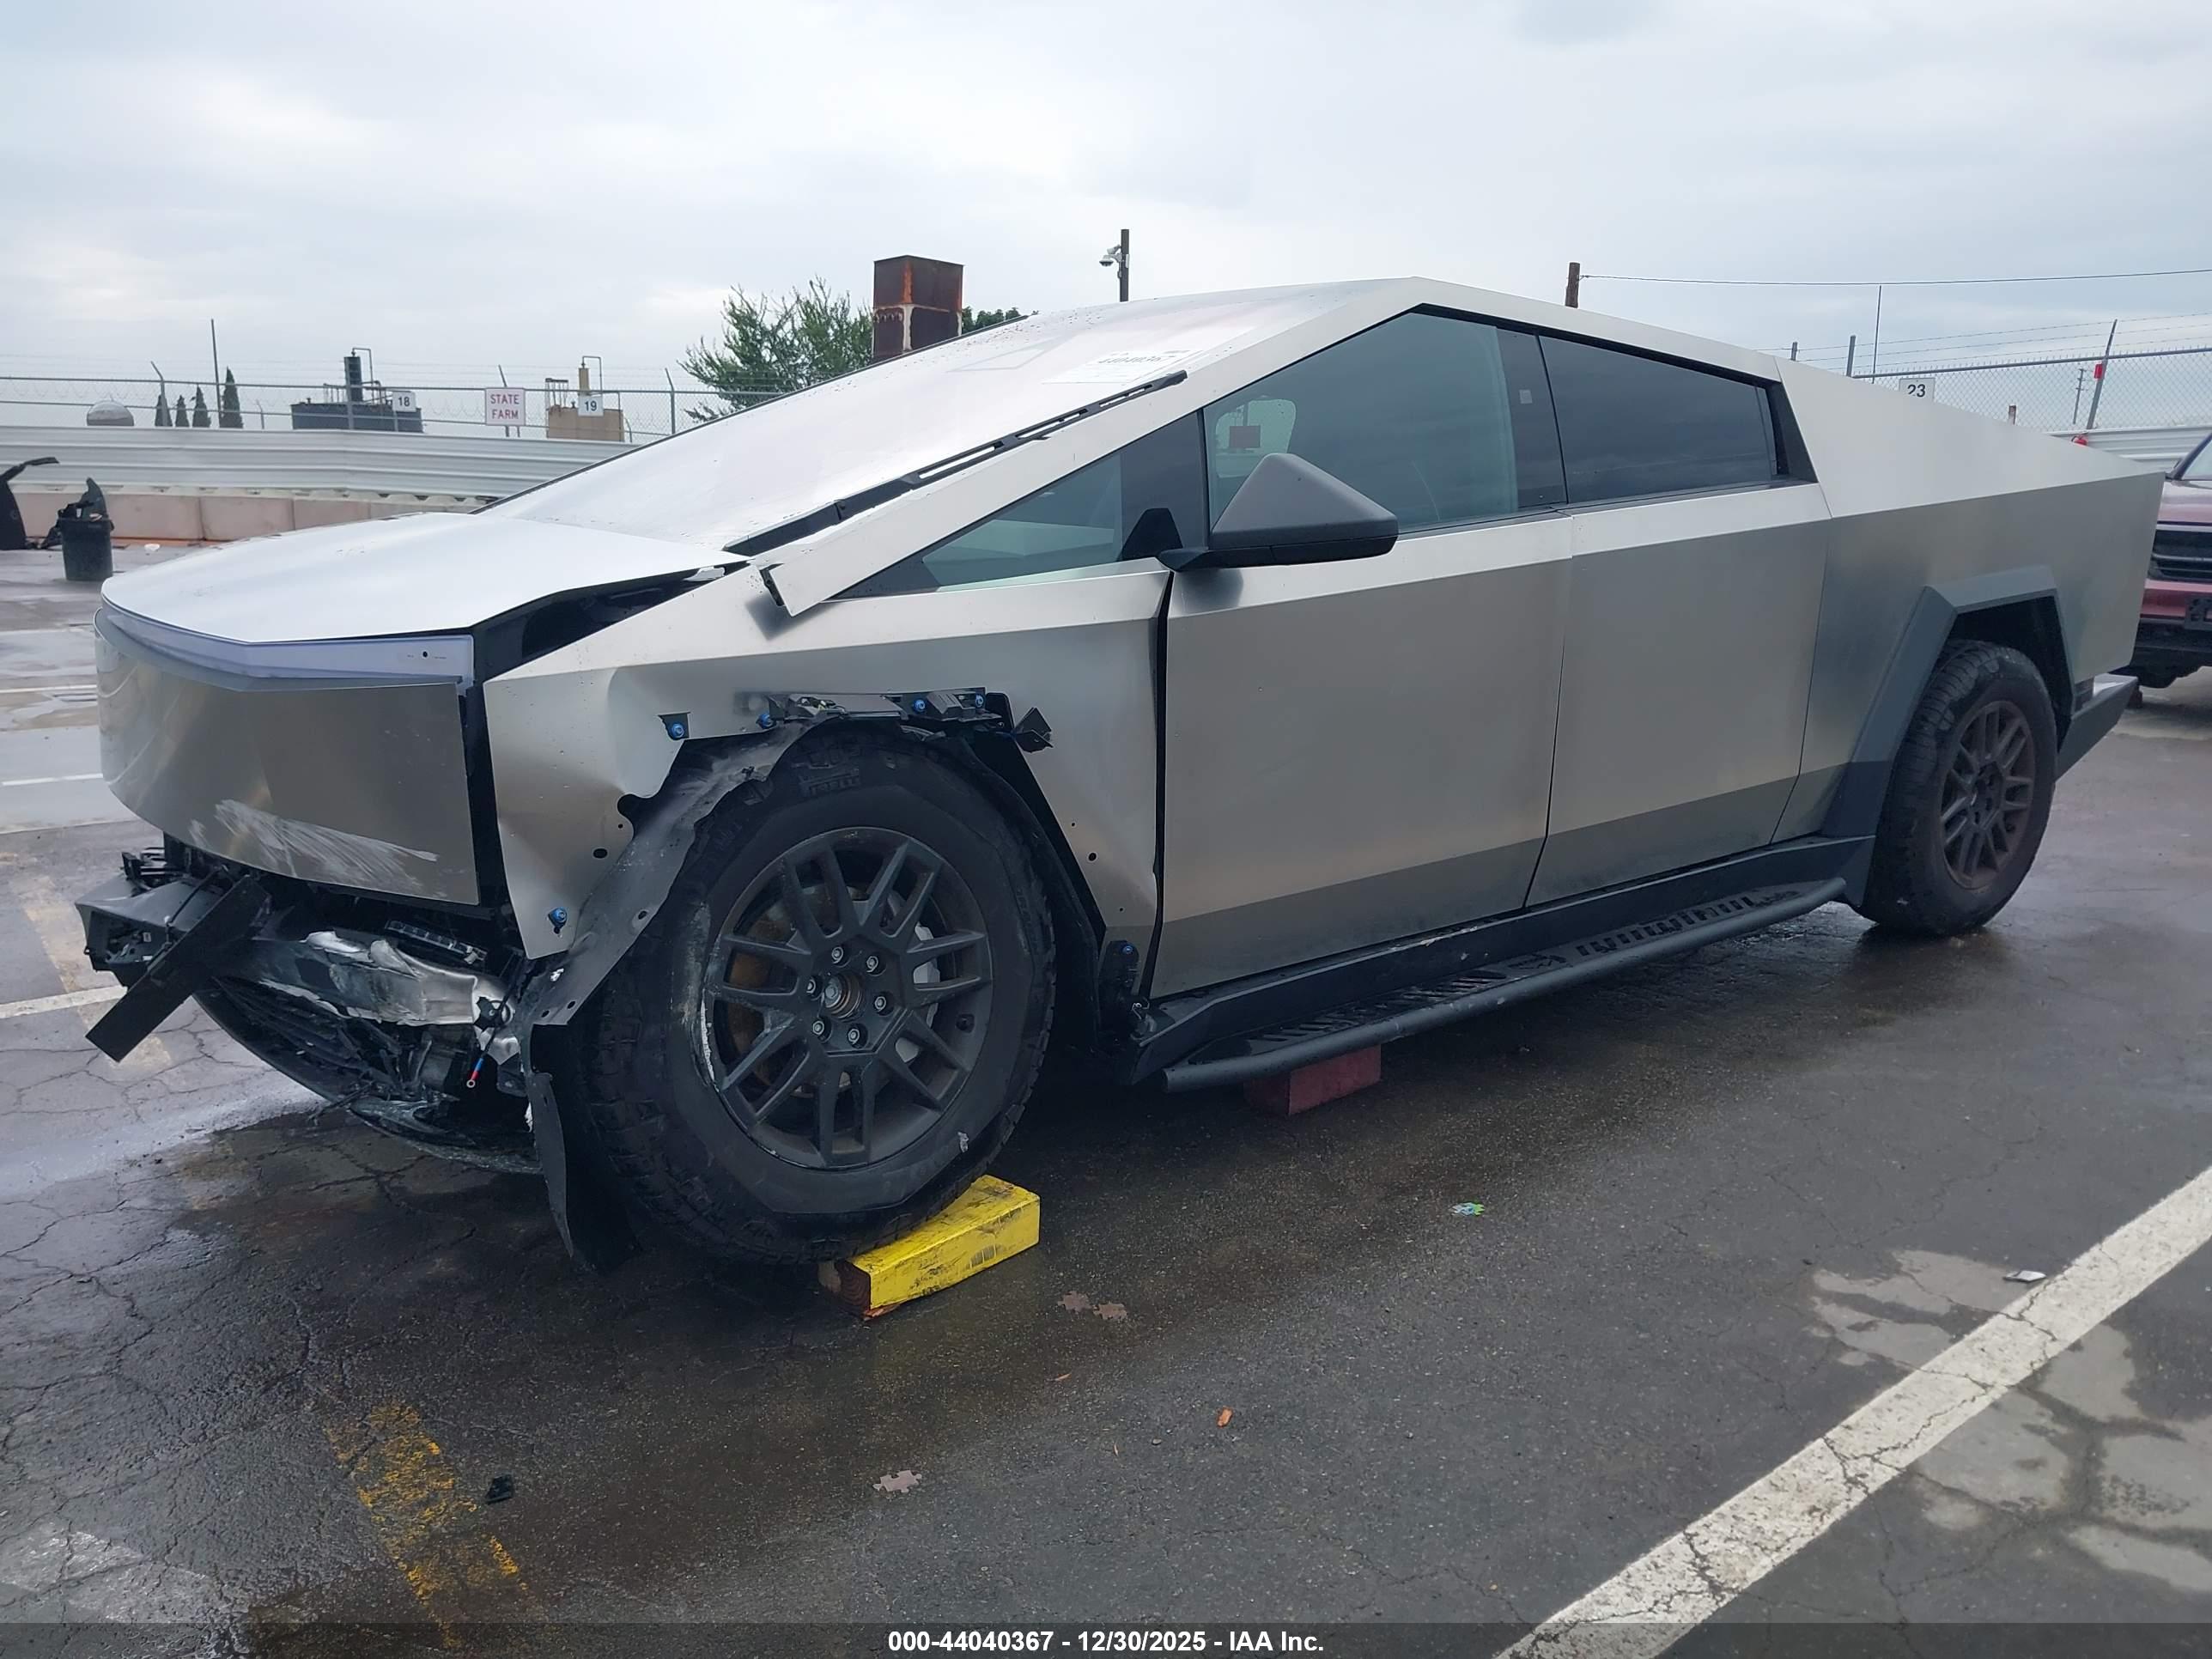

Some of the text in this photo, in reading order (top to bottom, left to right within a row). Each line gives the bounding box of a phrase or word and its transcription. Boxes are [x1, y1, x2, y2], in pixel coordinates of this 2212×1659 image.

[1907, 383, 1926, 398] 23
[398, 396, 410, 407] 18
[490, 393, 520, 405] STATE
[584, 400, 598, 411] 19
[491, 409, 519, 420] FARM
